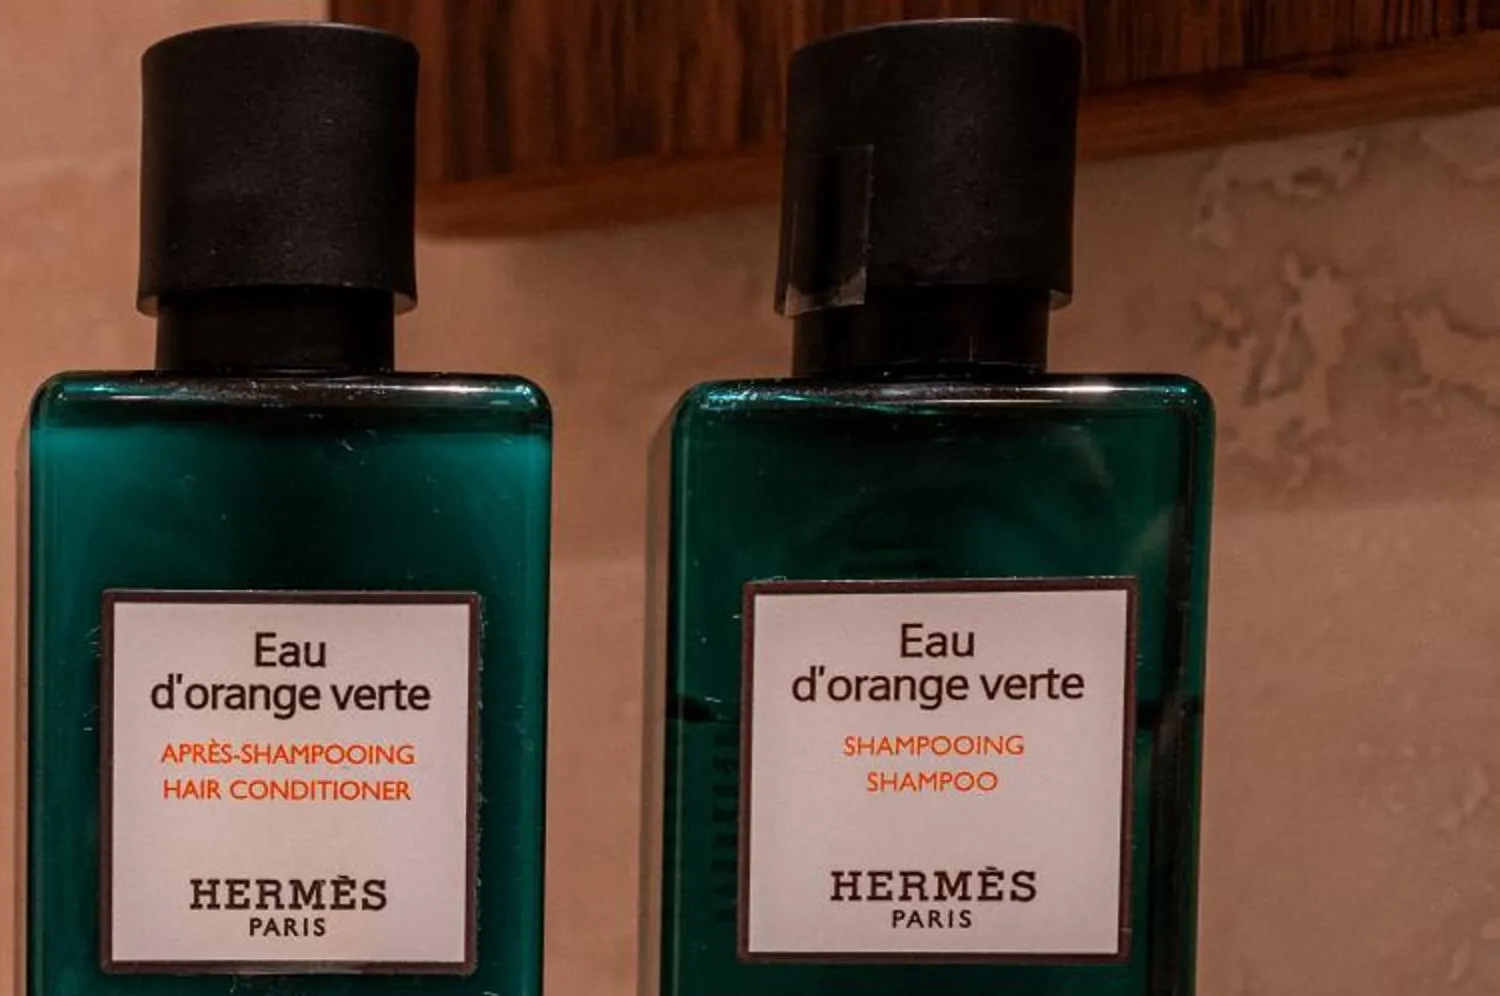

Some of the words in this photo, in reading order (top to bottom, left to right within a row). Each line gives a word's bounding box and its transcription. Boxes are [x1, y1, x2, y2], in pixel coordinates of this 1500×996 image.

[255, 632, 326, 668] Eau
[900, 623, 974, 658] Eau
[151, 673, 321, 720] d'orange
[330, 679, 431, 711] verte
[792, 665, 969, 710] d'orange
[980, 668, 1084, 700] verte
[161, 739, 414, 764] APRÈS-SHAMPOOING
[845, 736, 1024, 756] SHAMPOOING
[164, 780, 220, 799] HAIR
[230, 780, 410, 800] CONDITIONER
[868, 771, 997, 792] SHAMPOO
[190, 875, 387, 911] HERMÈS
[830, 866, 1037, 903] HERMÈS
[250, 917, 326, 937] PARIS
[892, 909, 972, 928] PARIS
